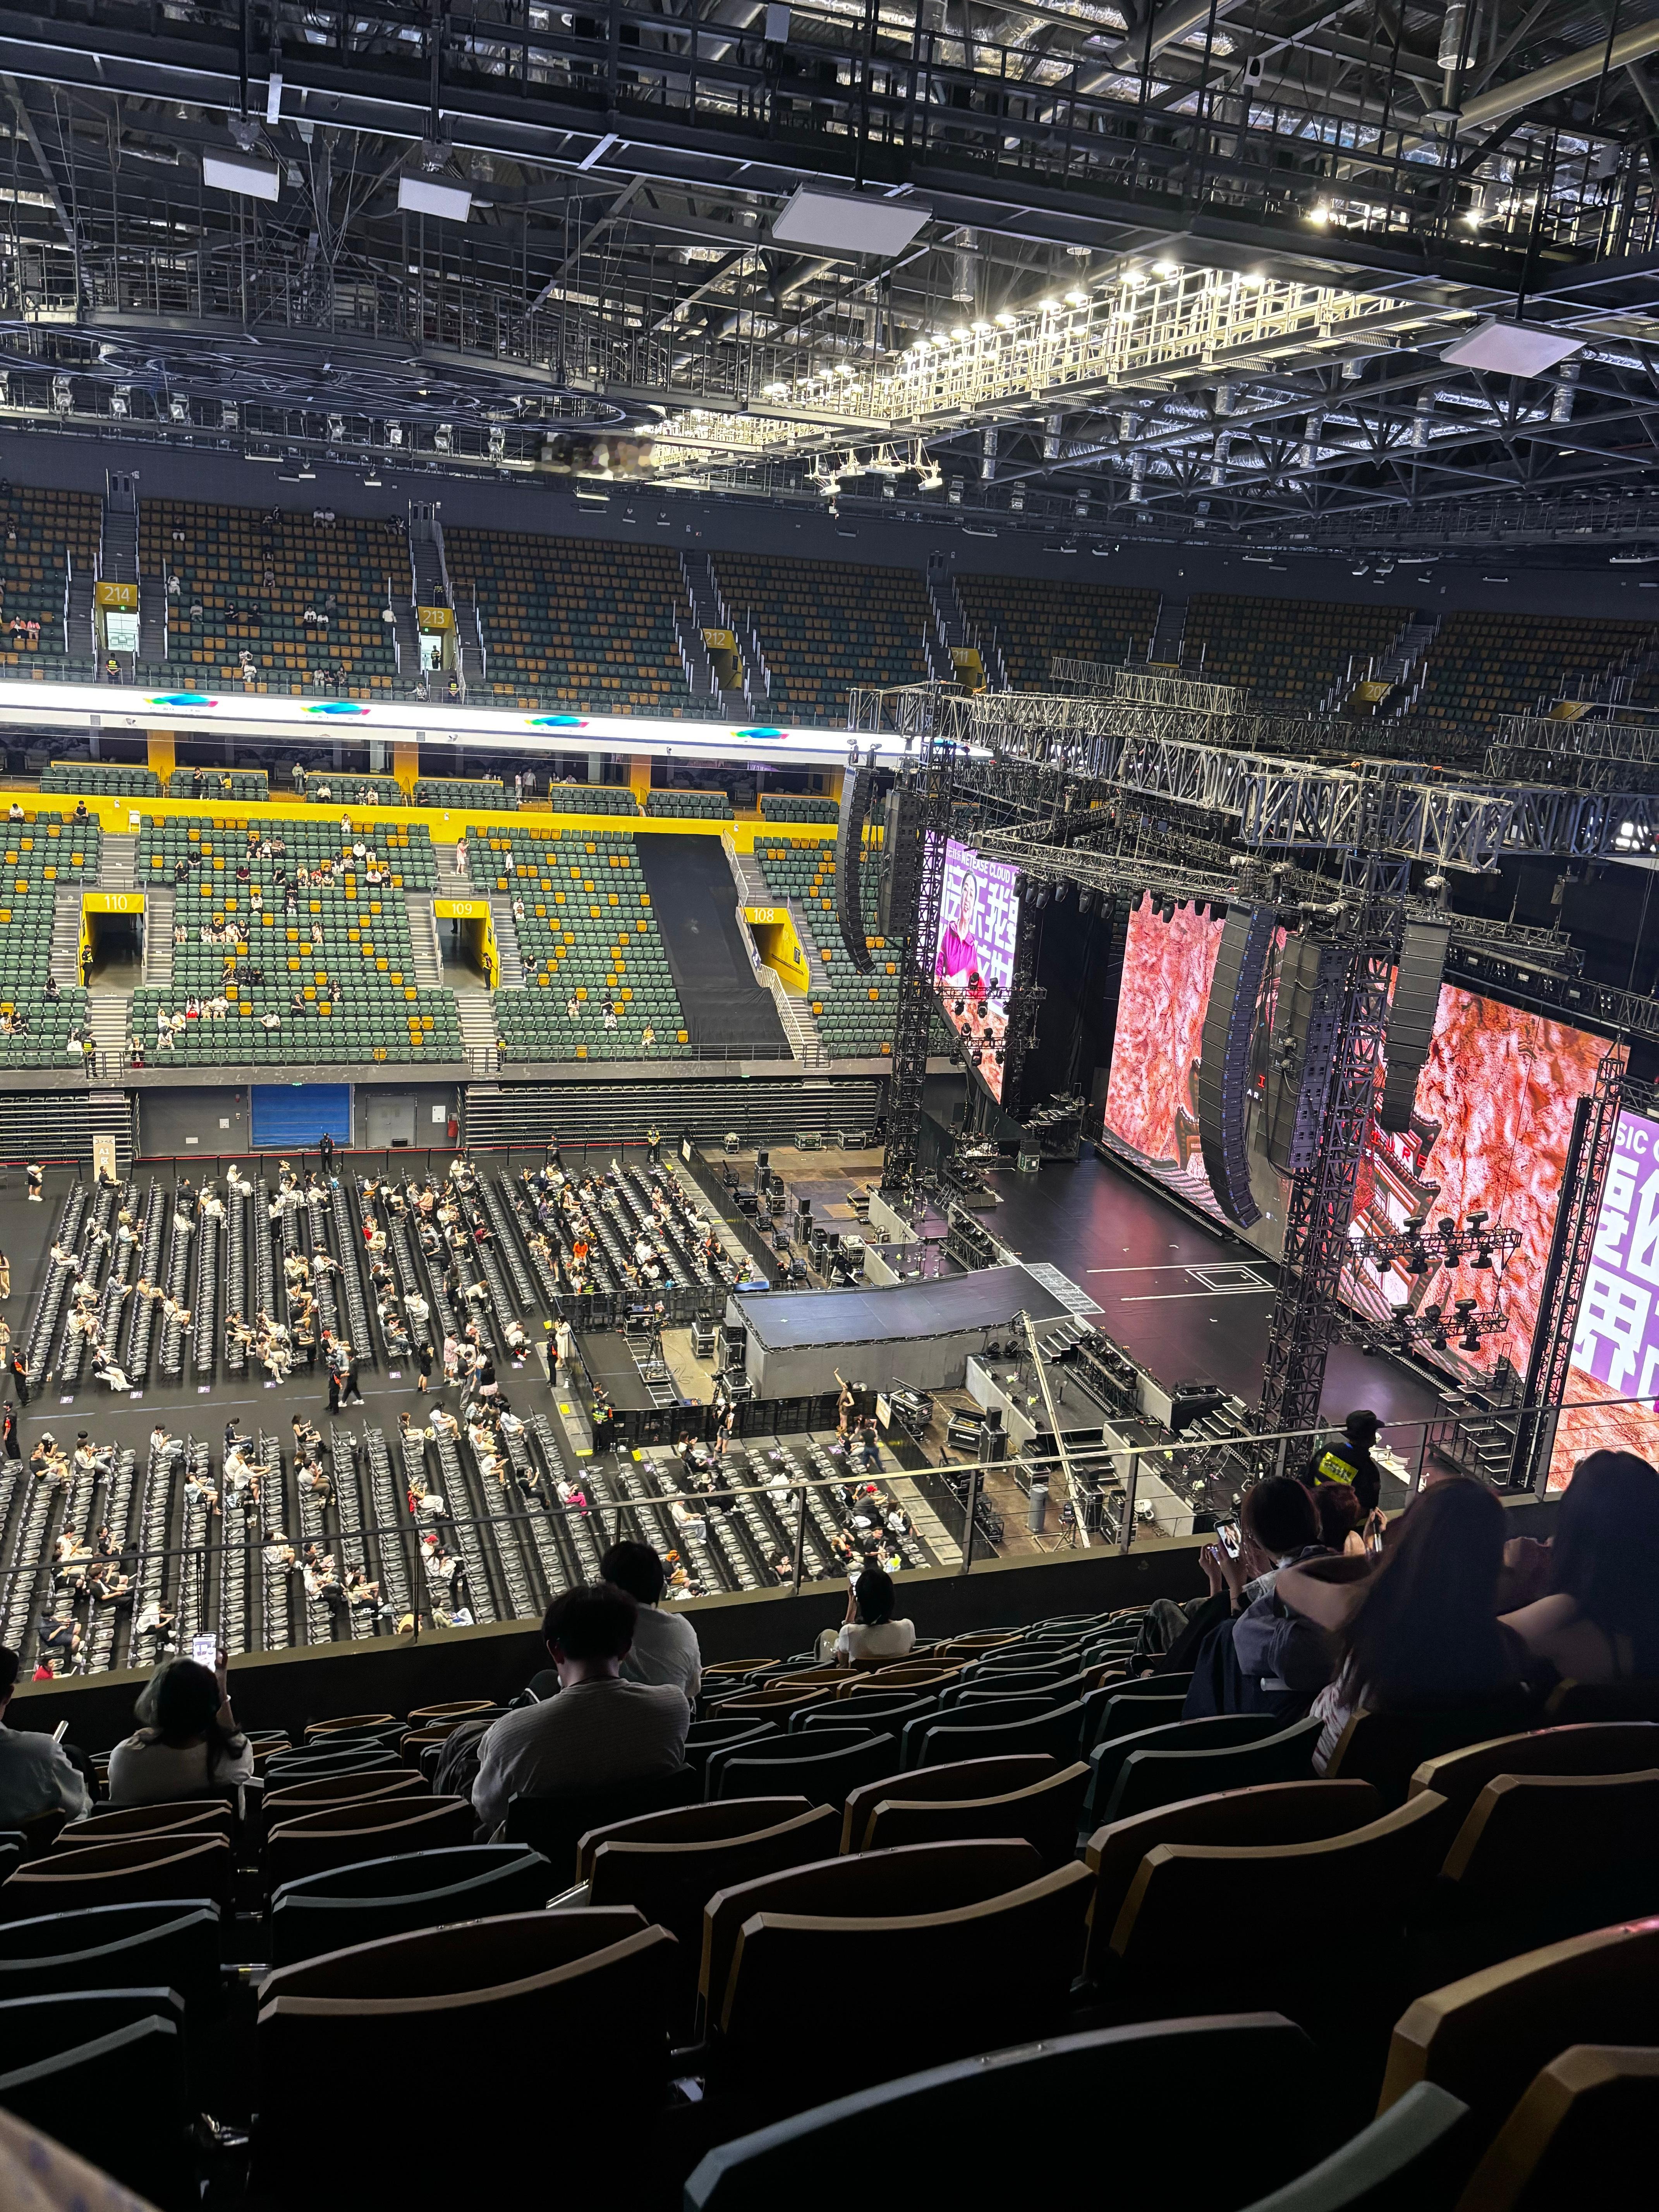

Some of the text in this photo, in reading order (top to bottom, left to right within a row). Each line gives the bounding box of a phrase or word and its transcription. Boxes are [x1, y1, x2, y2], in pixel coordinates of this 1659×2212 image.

[105, 586, 130, 602] 214
[423, 610, 444, 624] 213
[705, 632, 725, 645] 212
[952, 650, 968, 663] 211
[960, 850, 989, 875] NETEASE
[989, 862, 1010, 884] CLOUD
[104, 895, 127, 910] 110
[452, 903, 472, 915] 109
[754, 908, 774, 922] 108
